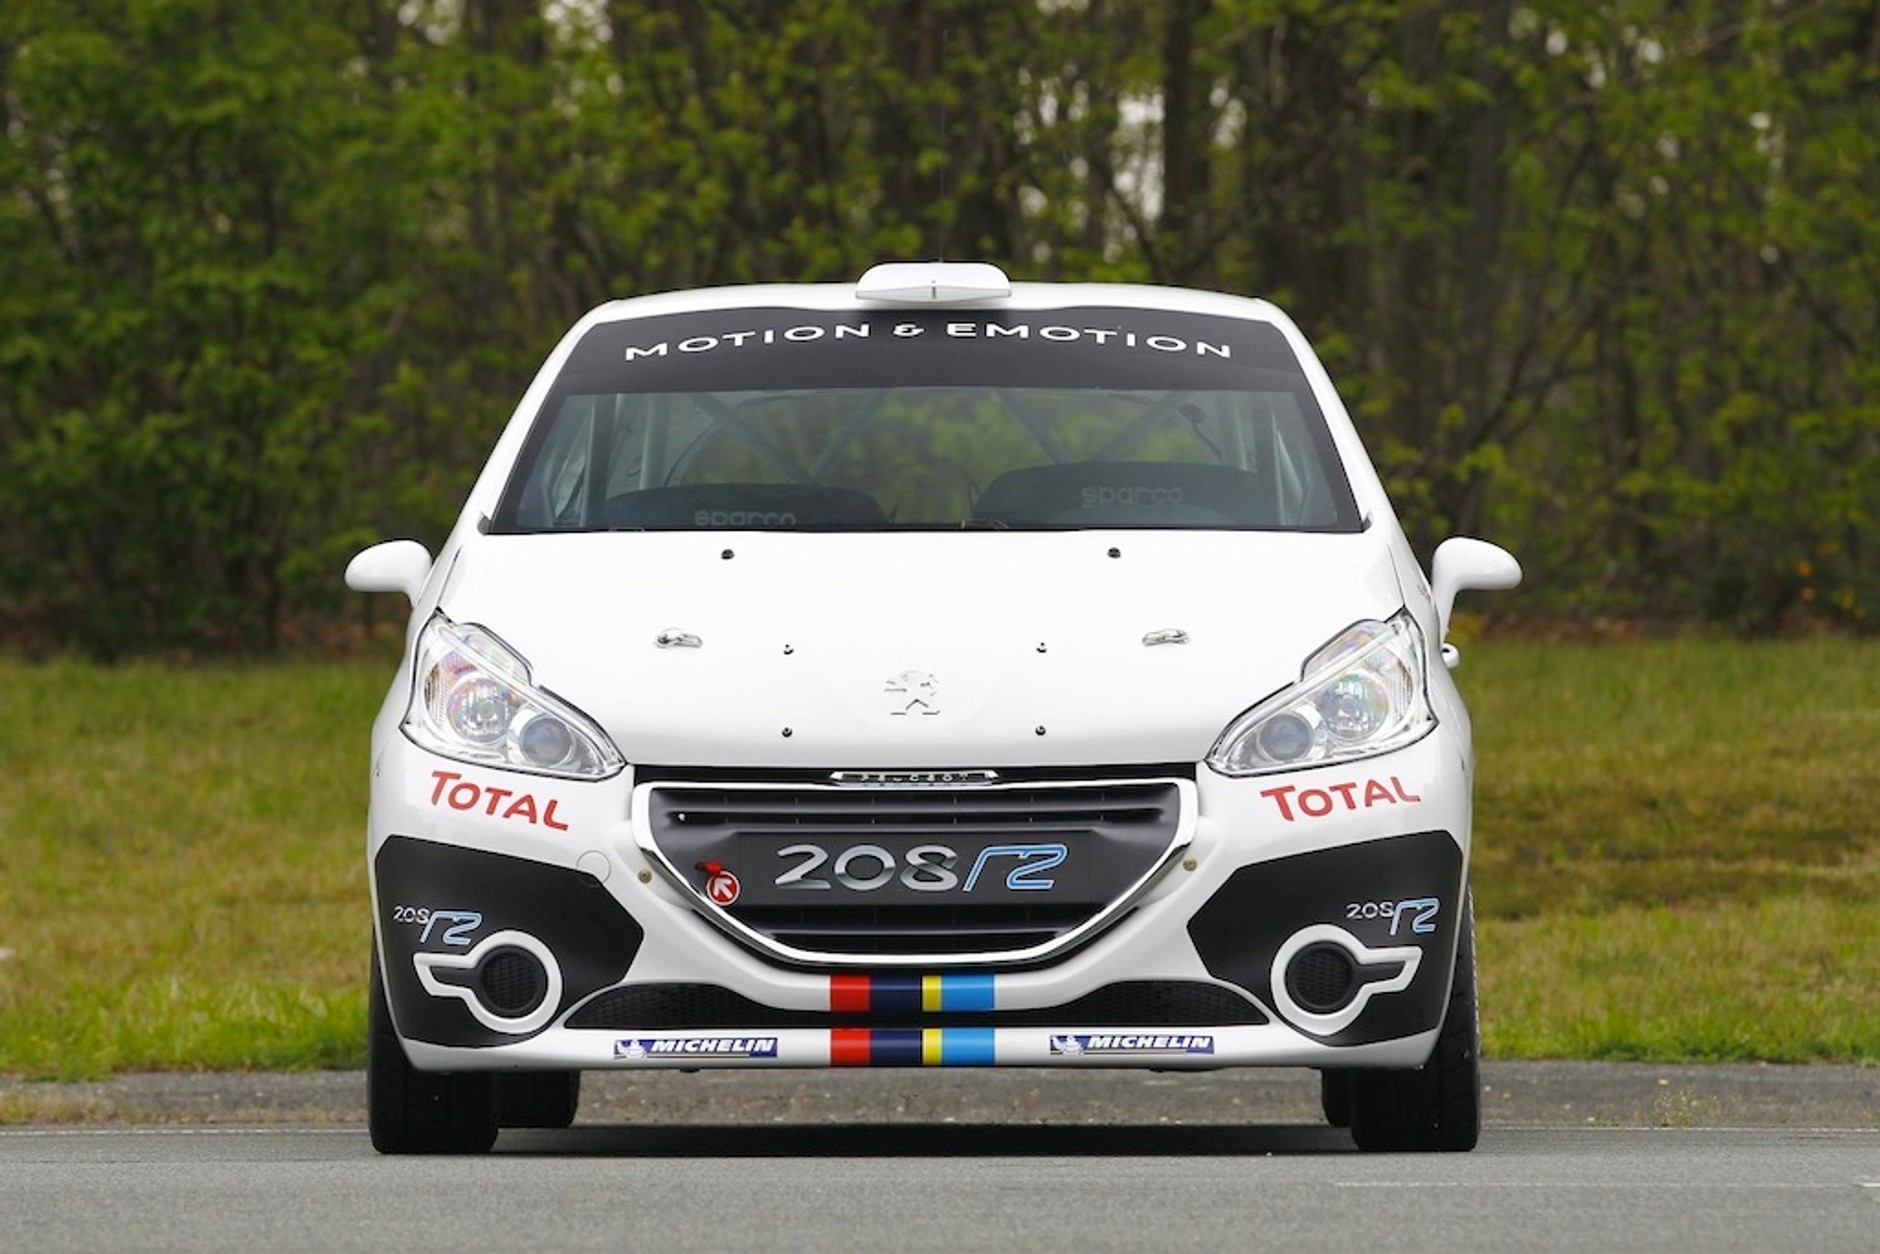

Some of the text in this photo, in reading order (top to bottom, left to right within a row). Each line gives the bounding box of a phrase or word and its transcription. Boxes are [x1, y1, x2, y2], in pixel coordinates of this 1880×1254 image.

[625, 323, 1231, 361] MOTION & EMOTION
[431, 771, 569, 831] TOTAL
[1260, 776, 1422, 822] TOTAL
[650, 1039, 775, 1052] MICHELIN
[1088, 1037, 1211, 1049] MICHELIN
